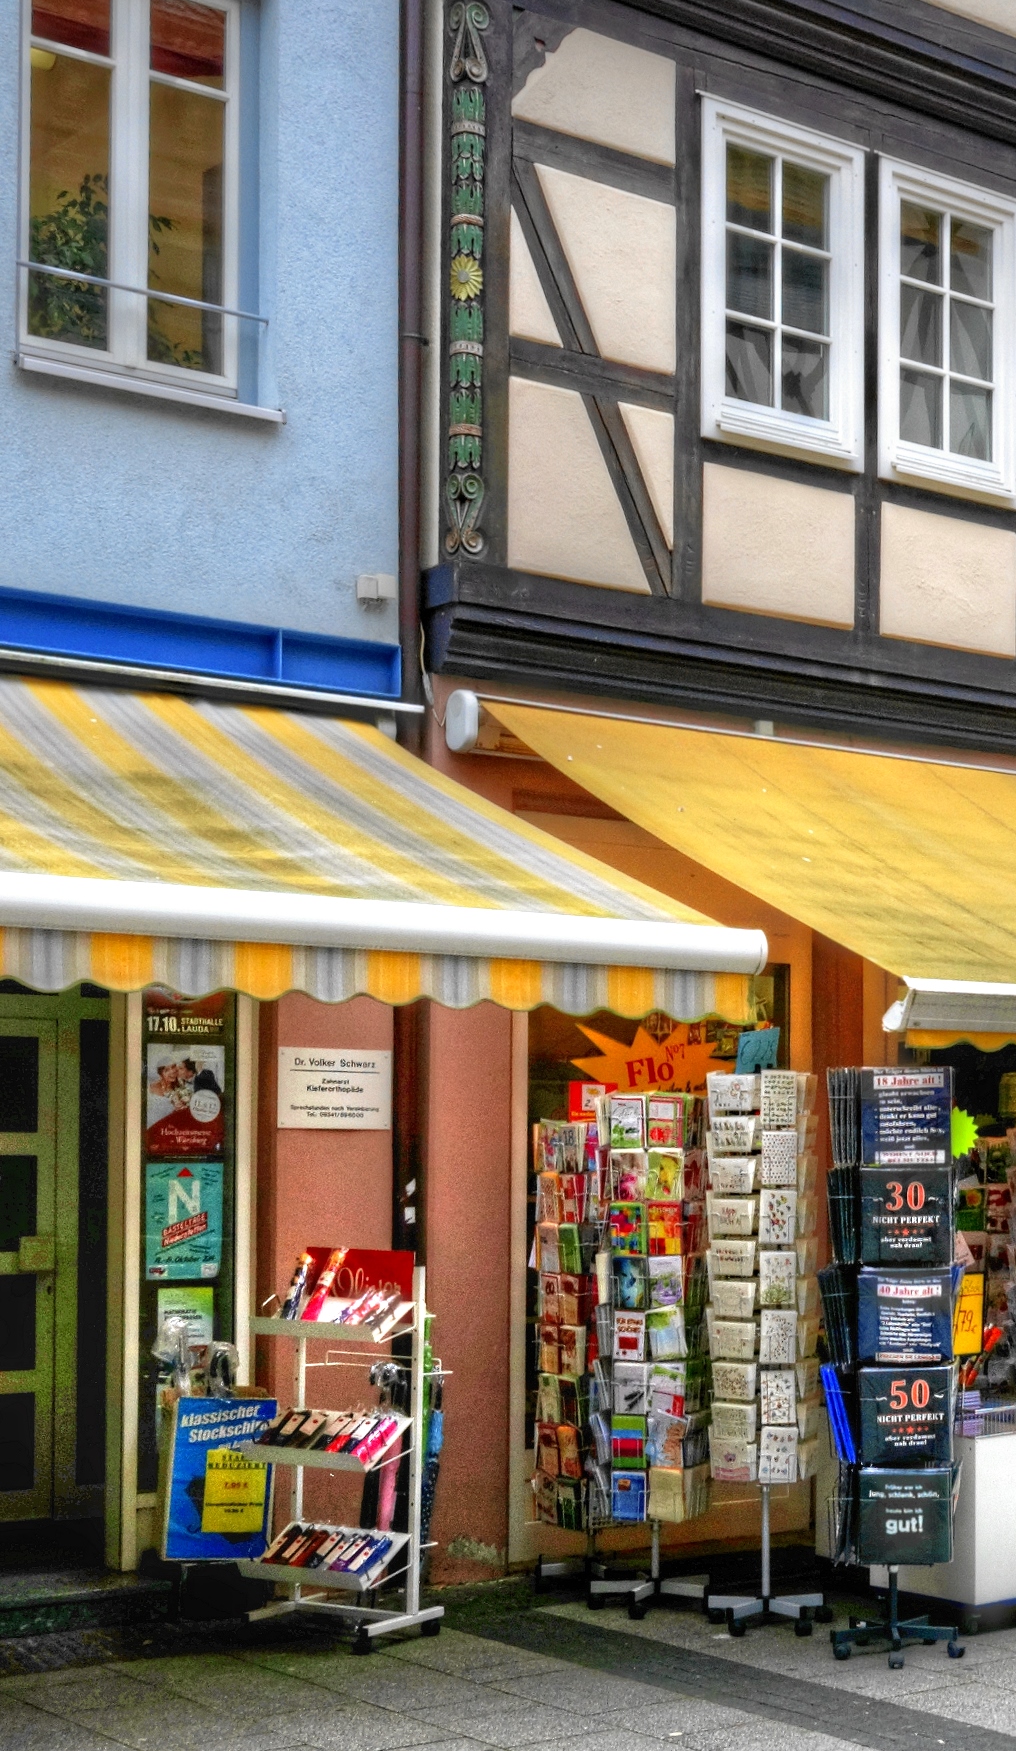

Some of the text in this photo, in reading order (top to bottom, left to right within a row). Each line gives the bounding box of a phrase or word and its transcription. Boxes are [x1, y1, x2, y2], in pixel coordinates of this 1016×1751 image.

[147, 1016, 181, 1032] 17.10.
[181, 1017, 224, 1026] STADTHALLE
[295, 1058, 376, 1068] Dr. Volker Schwarz
[625, 1056, 674, 1087] Flo
[877, 1077, 888, 1086] 18
[891, 1076, 919, 1086] Jahre
[922, 1076, 935, 1085] alt
[306, 1085, 364, 1094] Kieferorthopäde
[168, 1179, 201, 1224] N
[885, 1181, 925, 1211] 30
[872, 1215, 940, 1224] NICHT PERFEKT
[893, 1286, 919, 1295] Jahre
[921, 1286, 933, 1295] alt
[889, 1379, 930, 1410] 50
[181, 1405, 261, 1427] klassischer
[876, 1413, 944, 1423] NICHT PERFEKT
[885, 1515, 924, 1535] gut!
